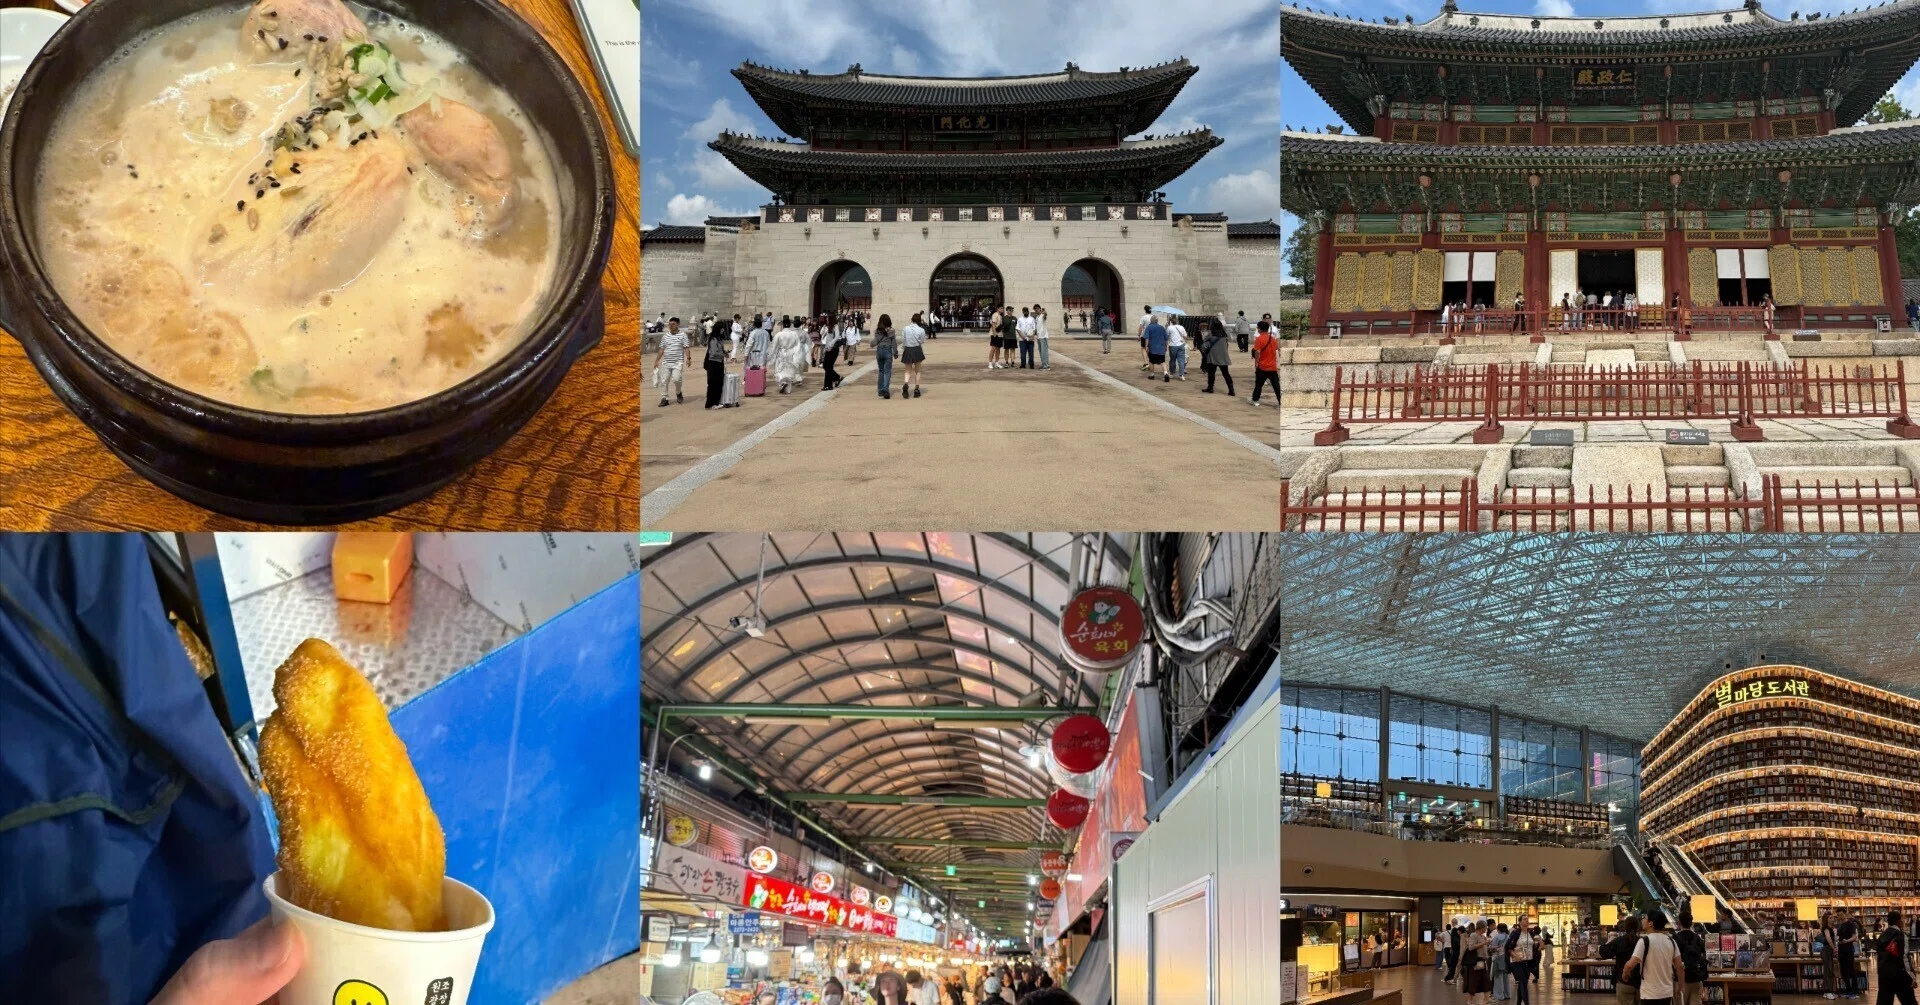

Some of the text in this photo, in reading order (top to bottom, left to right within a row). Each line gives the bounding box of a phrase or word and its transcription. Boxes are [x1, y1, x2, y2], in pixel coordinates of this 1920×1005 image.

[1094, 640, 1128, 653] 육회
[1715, 679, 1810, 709] 별마당 도서관
[431, 980, 450, 993] 원조
